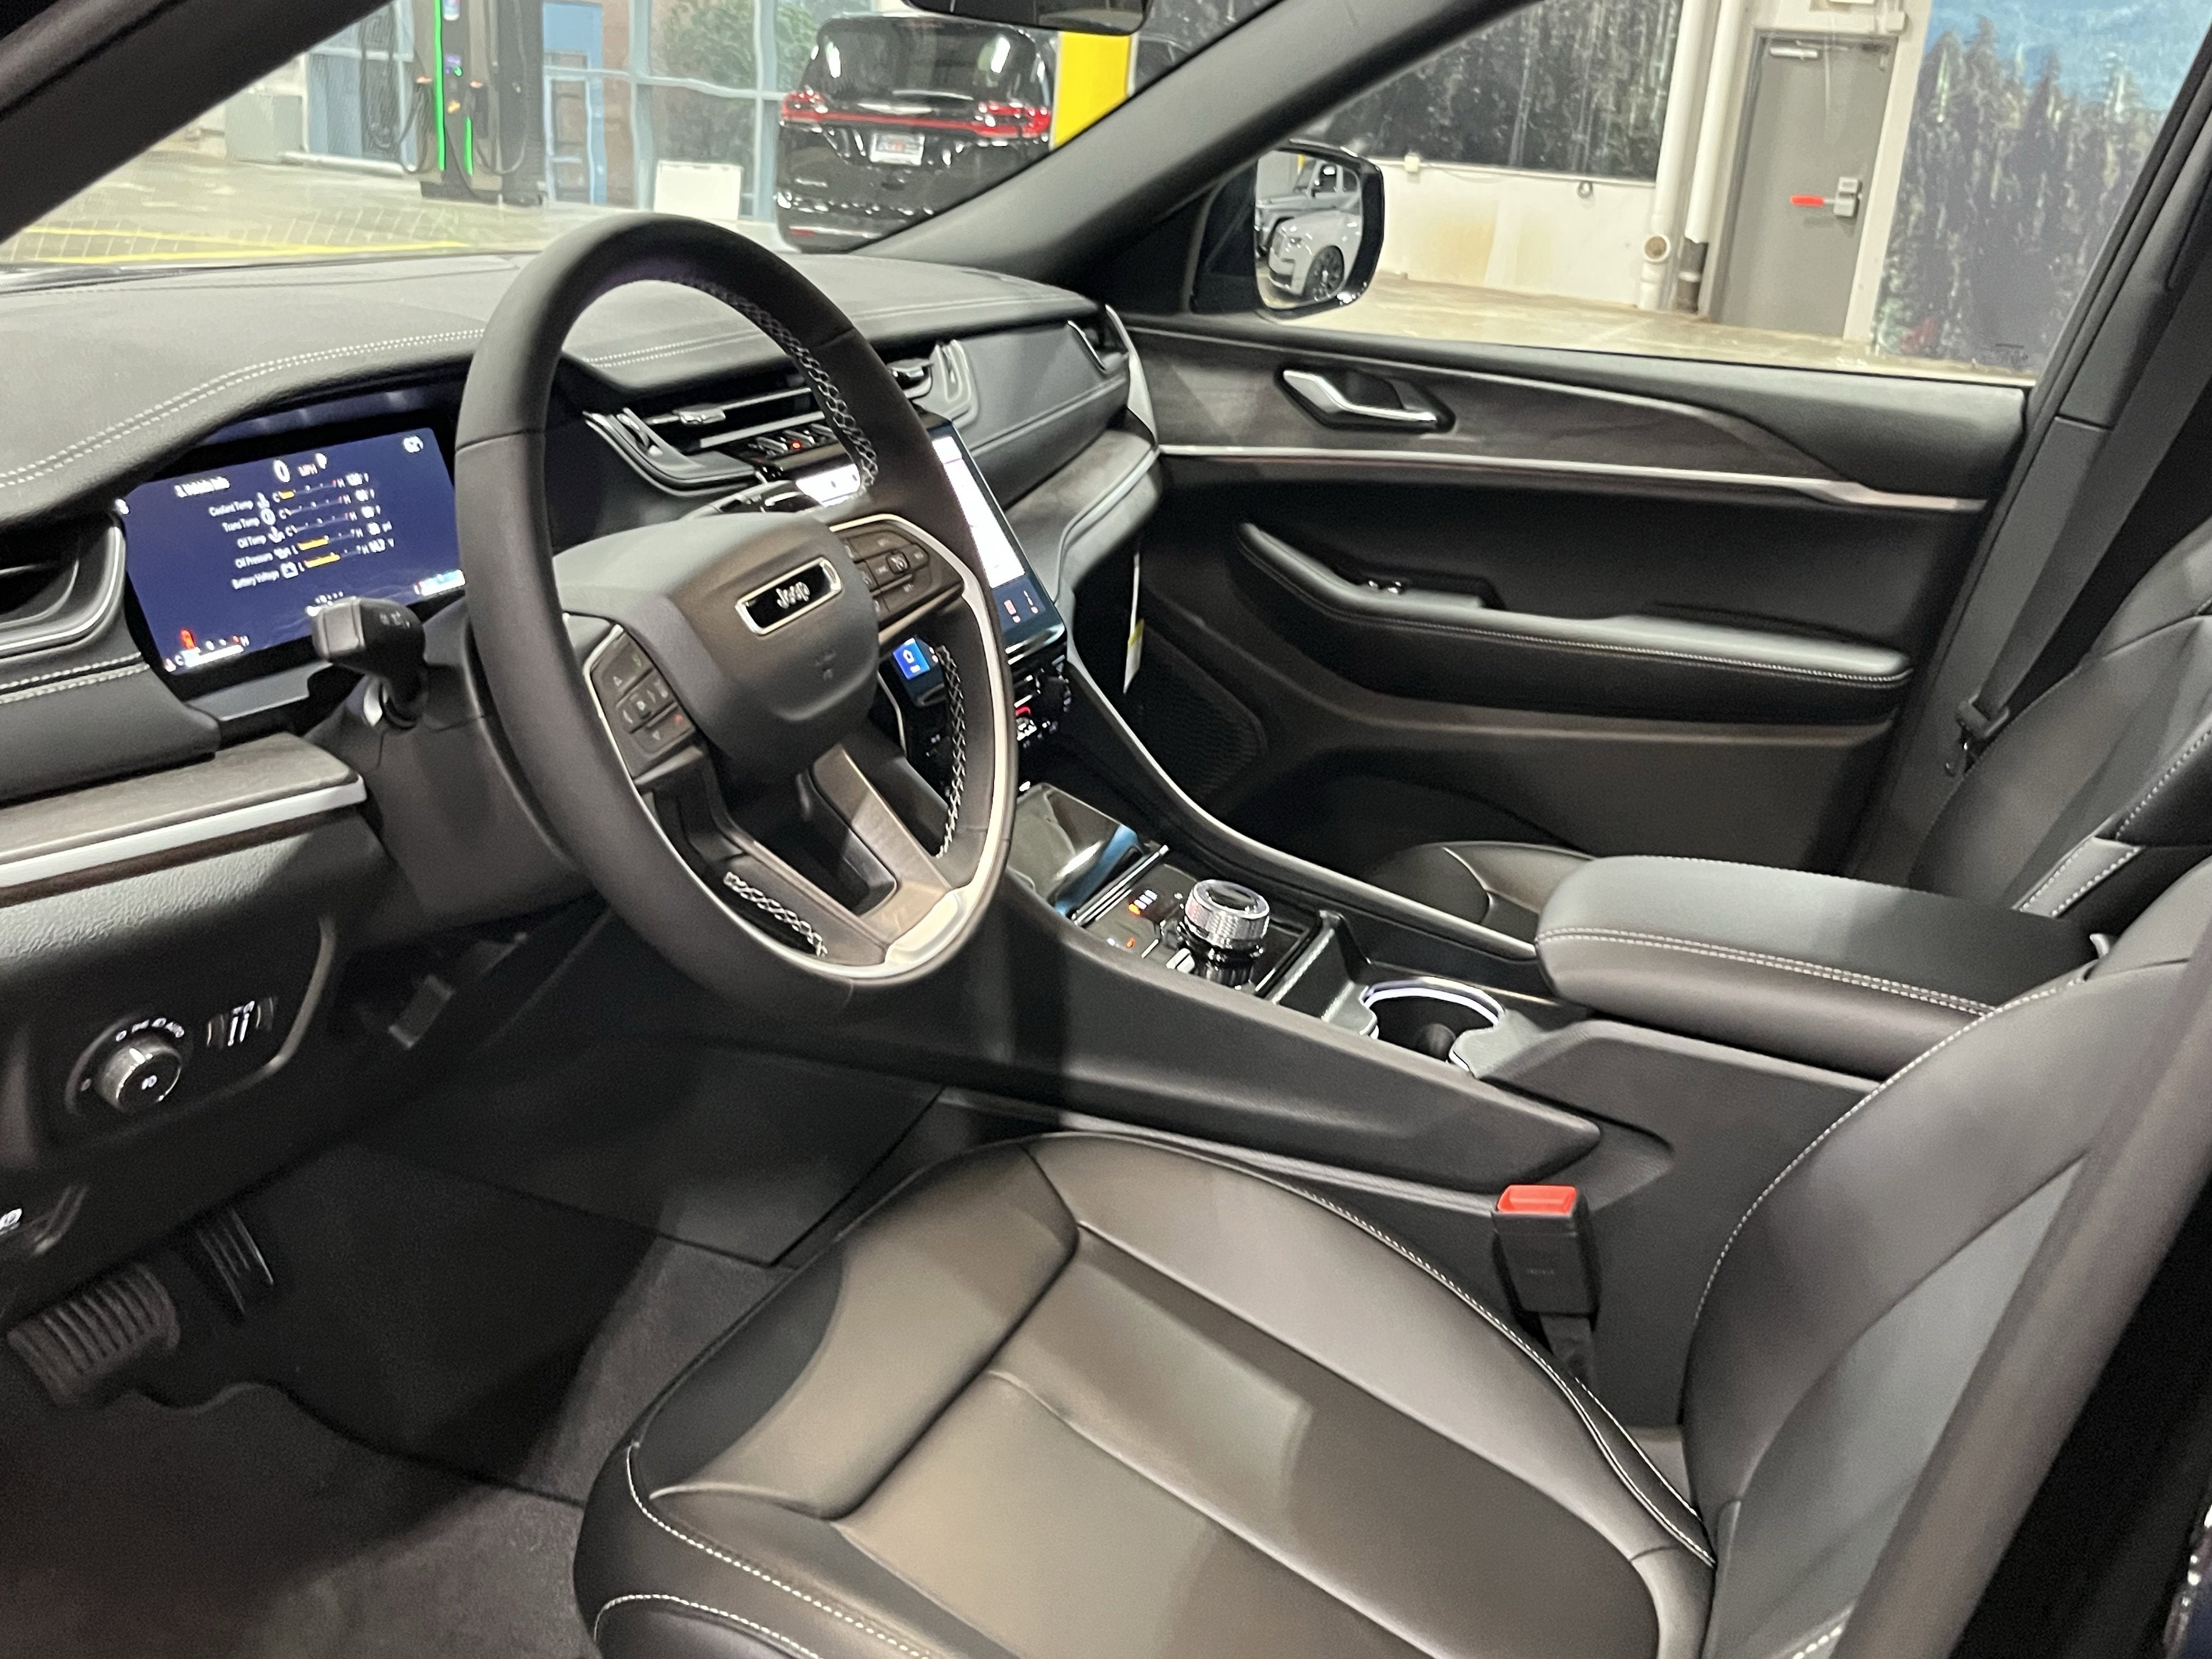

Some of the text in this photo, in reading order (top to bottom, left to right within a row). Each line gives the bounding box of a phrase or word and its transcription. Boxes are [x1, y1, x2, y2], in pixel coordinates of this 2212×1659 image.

[208, 504, 236, 517] Coolant
[234, 500, 254, 511] Temp
[222, 521, 242, 533] Trans
[239, 517, 261, 528] Temp
[237, 537, 249, 549] Oil
[247, 535, 267, 546] Temp
[235, 557, 247, 569] Oil
[245, 552, 274, 566] Pressure
[231, 576, 257, 590] Battery
[254, 570, 280, 583] Voltage
[776, 582, 810, 609] Jeep
